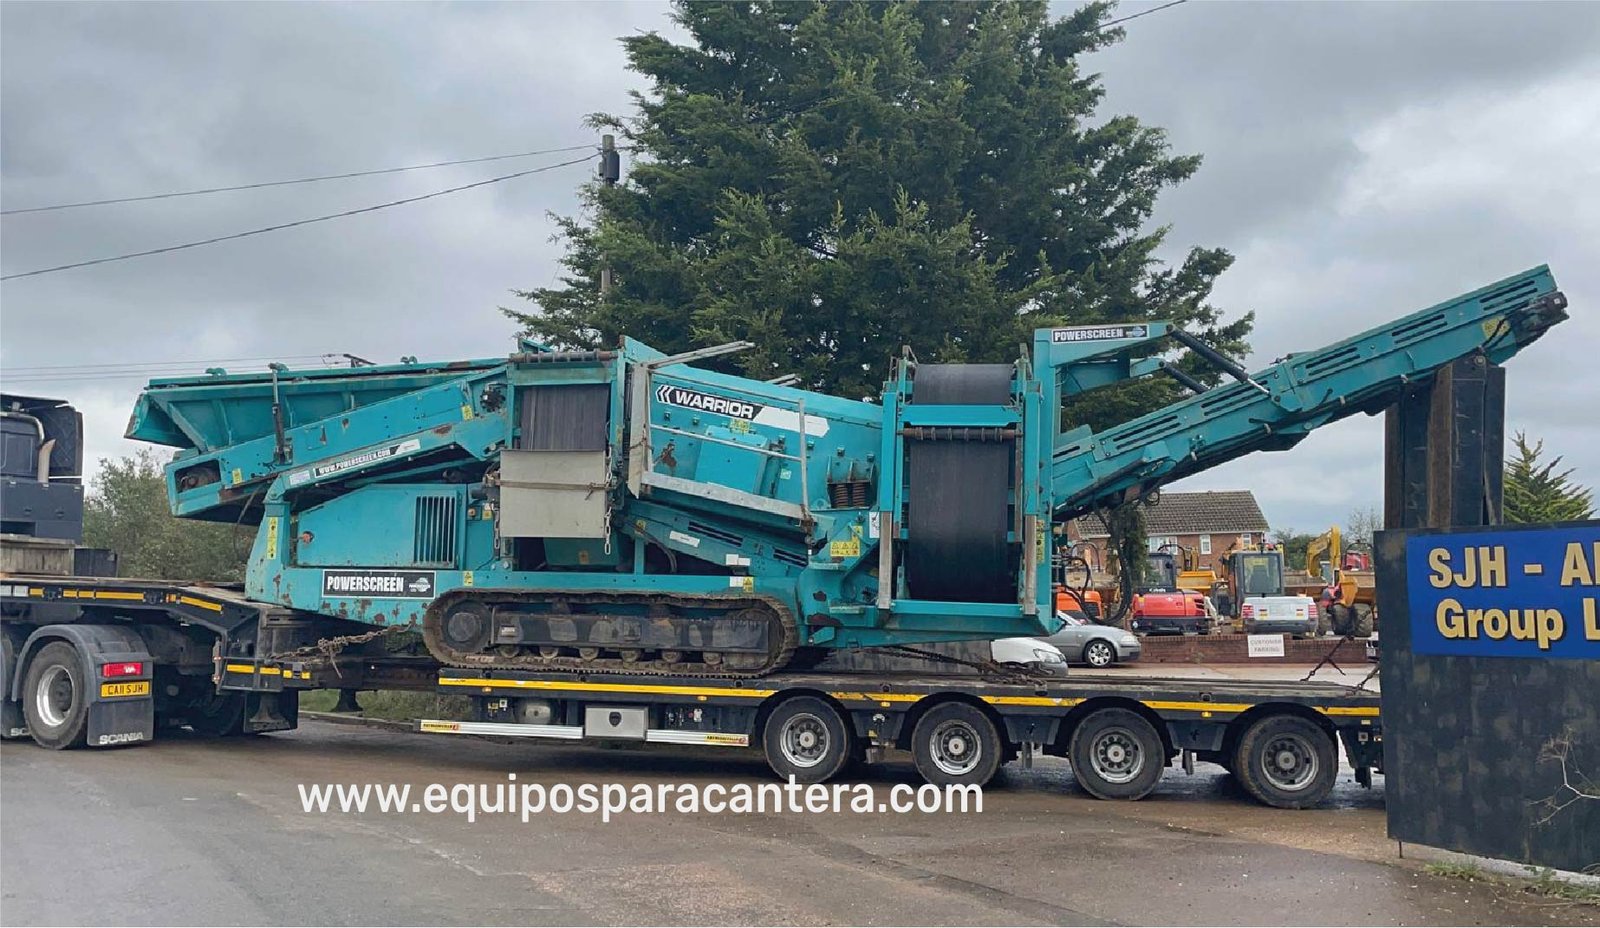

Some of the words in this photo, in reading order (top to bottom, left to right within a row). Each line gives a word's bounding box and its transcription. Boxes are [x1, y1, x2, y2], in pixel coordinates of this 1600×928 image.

[1054, 328, 1124, 342] POWERSCREEN
[675, 390, 754, 419] WARRIOR
[1429, 546, 1507, 589] SJH
[1523, 563, 1543, 574] -
[327, 575, 405, 593] POWERSCREEN
[1436, 598, 1565, 650] Group
[99, 731, 144, 745] SCANIA
